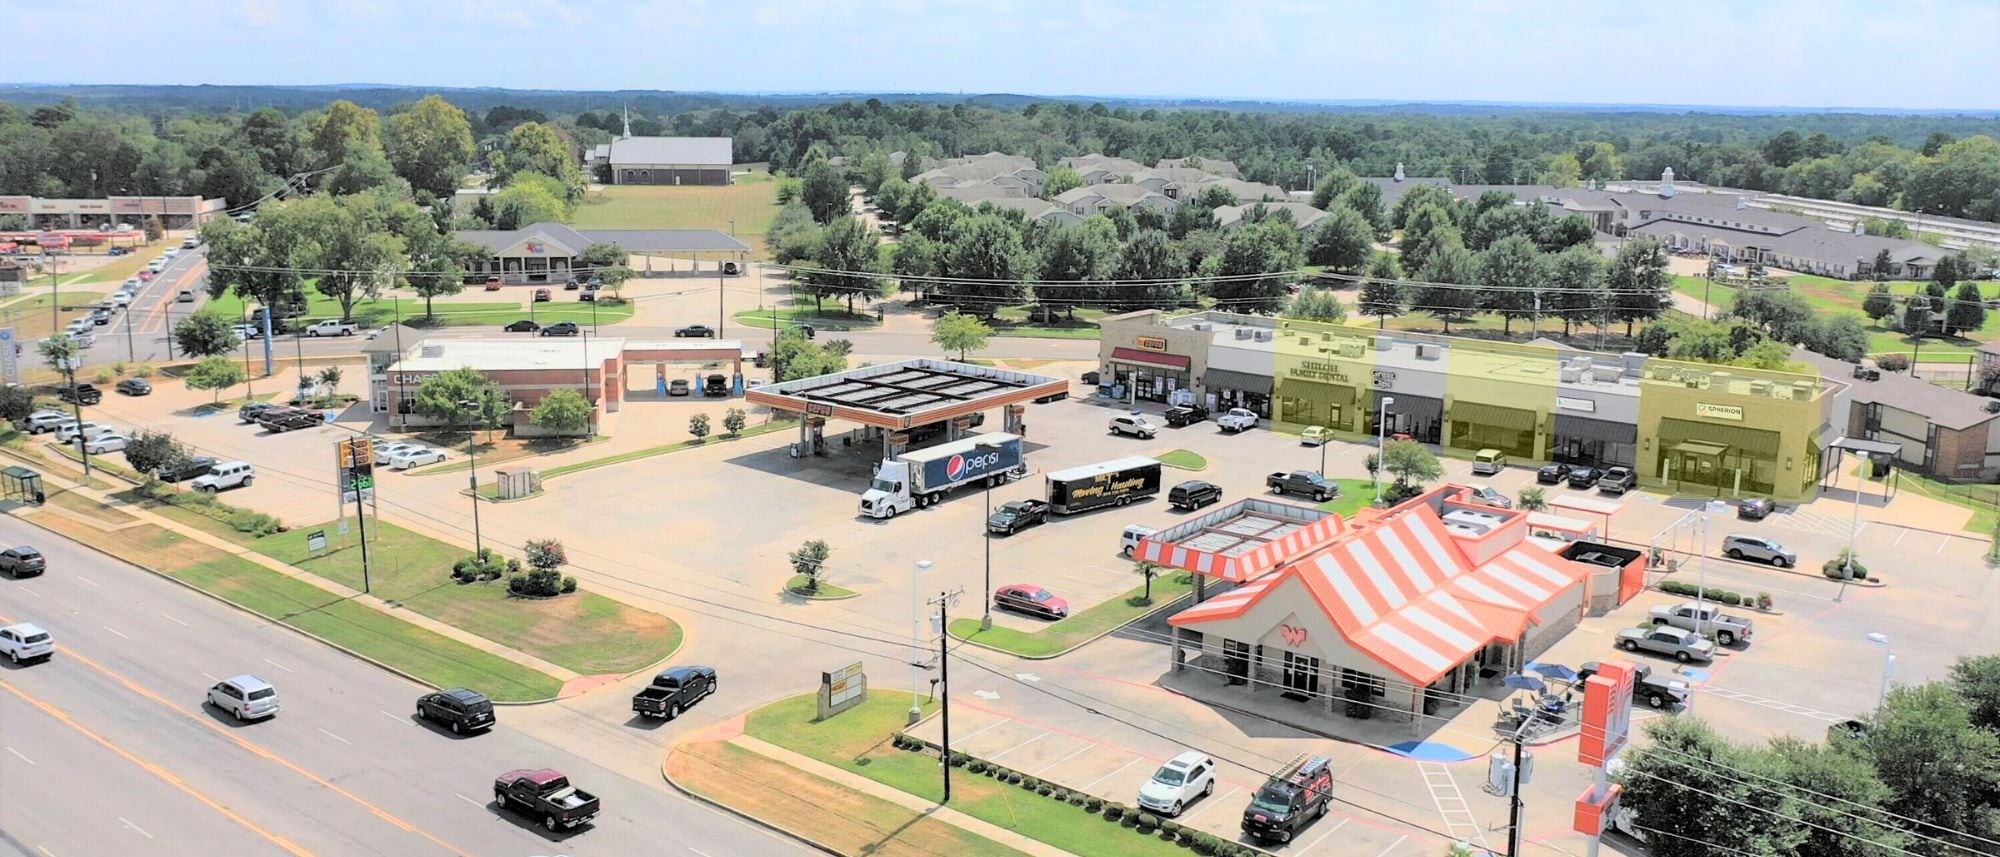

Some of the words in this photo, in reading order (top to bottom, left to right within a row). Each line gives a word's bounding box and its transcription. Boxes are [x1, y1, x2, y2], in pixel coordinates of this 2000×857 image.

[1301, 360, 1338, 372] SHILOH
[1290, 368, 1316, 379] FAMILY
[1319, 372, 1348, 383] DENTAL
[1708, 405, 1741, 415] SPHERION
[965, 452, 999, 474] pepsi
[1071, 486, 1105, 498] Moving
[1110, 477, 1145, 490] Hauling
